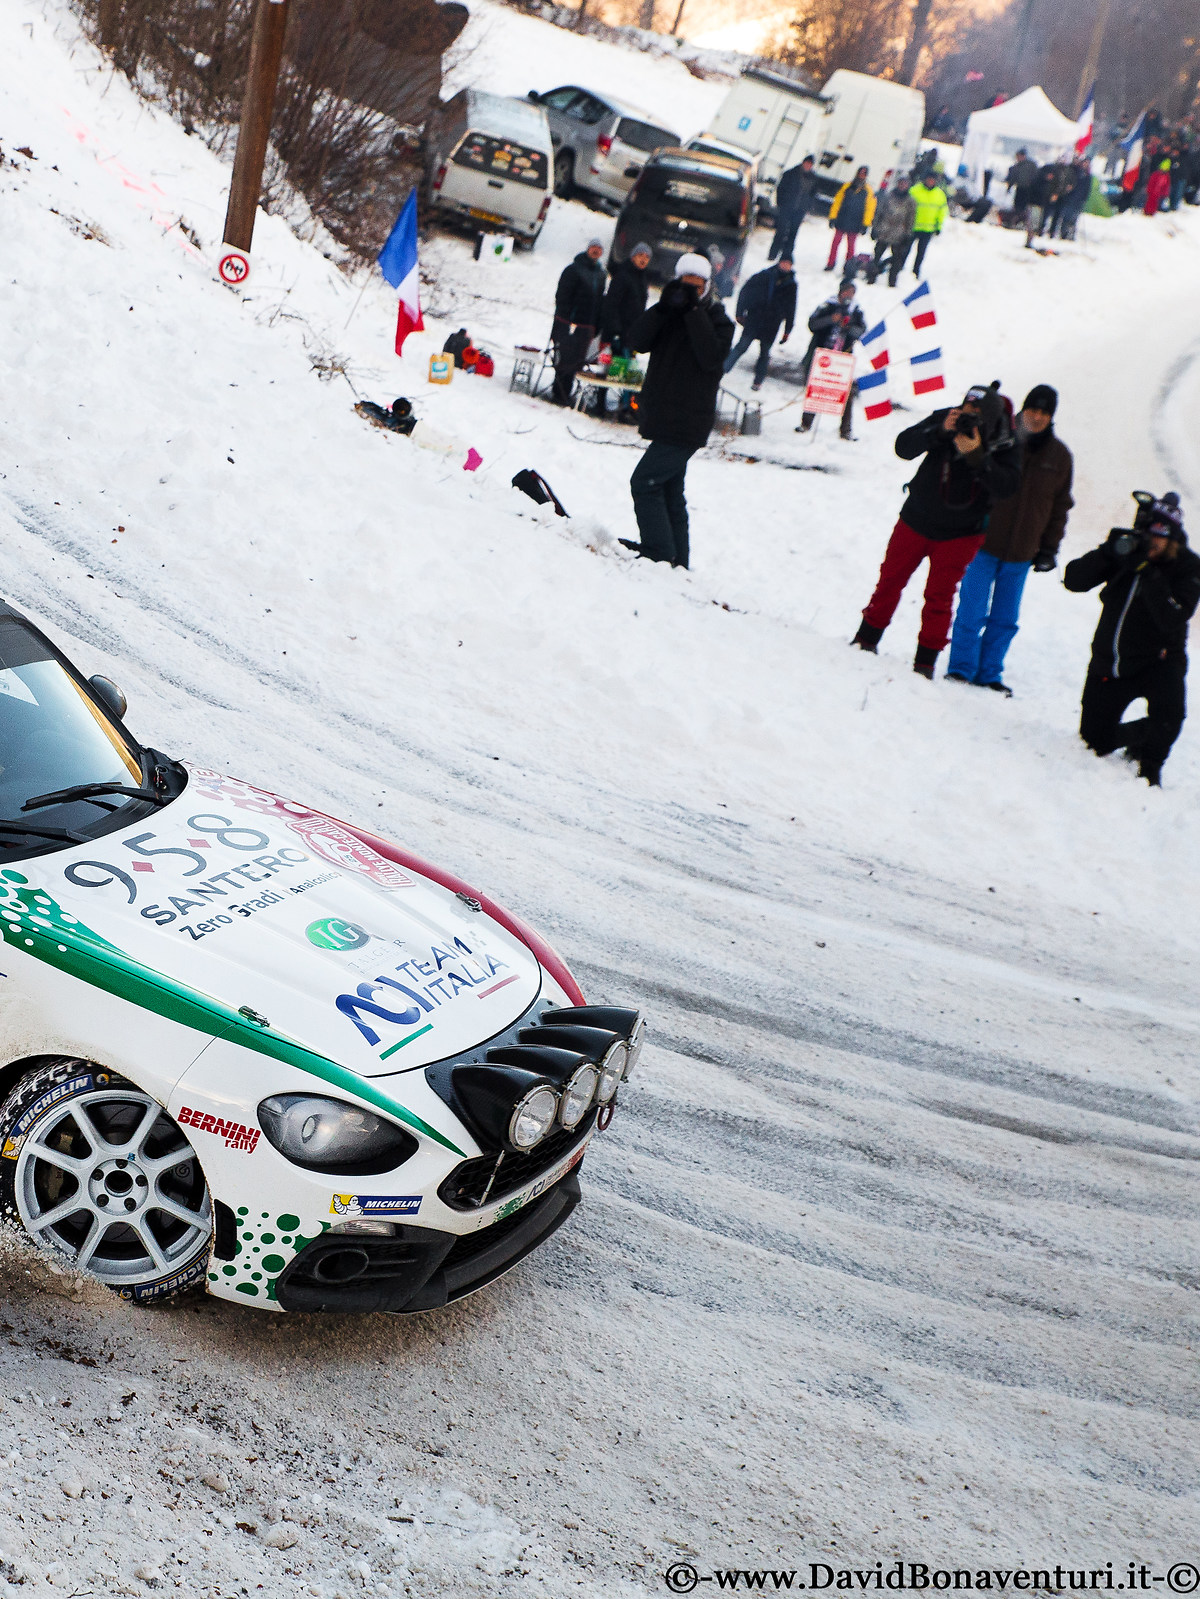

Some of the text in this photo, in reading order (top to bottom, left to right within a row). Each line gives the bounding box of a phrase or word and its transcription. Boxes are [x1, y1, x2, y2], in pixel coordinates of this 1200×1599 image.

[140, 847, 311, 926] SANTERO
[179, 914, 232, 941] Zero
[227, 890, 284, 918] Gradi
[312, 919, 361, 949] IG
[395, 936, 473, 982] TEAM
[422, 953, 510, 1006] ITALIA
[17, 1076, 90, 1133] MICHELIN
[176, 1106, 262, 1144] BERNINI
[224, 1138, 257, 1154] rally
[364, 1199, 422, 1209] MICHELIN
